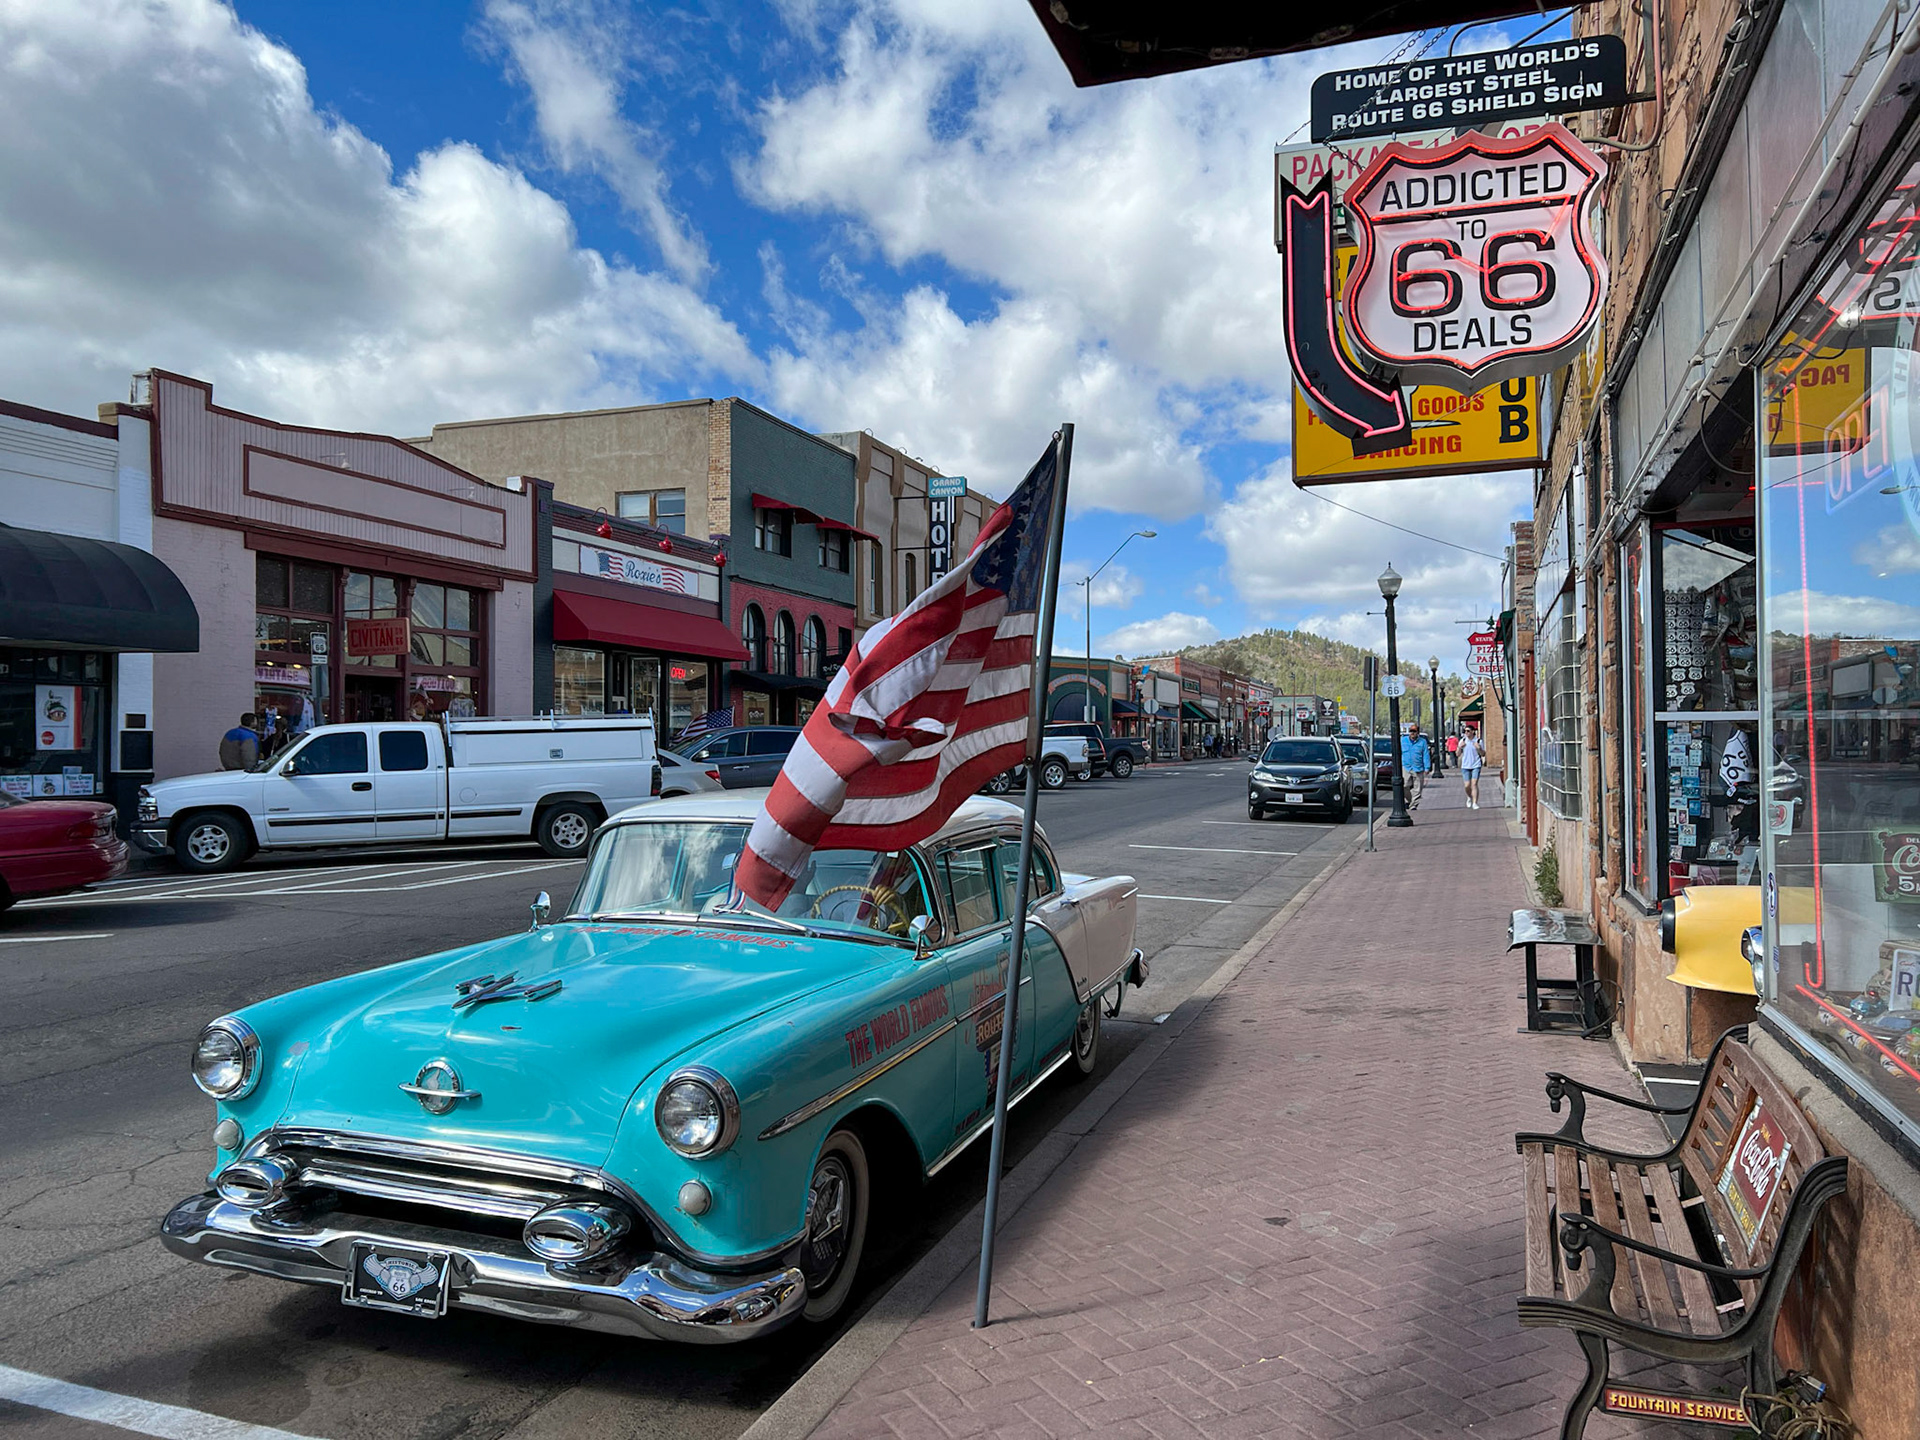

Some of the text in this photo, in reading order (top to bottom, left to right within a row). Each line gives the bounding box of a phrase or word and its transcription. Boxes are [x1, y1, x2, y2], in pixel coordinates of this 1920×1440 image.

[1335, 42, 1600, 92] HOME OF THE WORLD'S
[1375, 69, 1556, 106] LARGEST STEEL
[1332, 82, 1603, 131] ROUTE 66 SHIELD SIGN
[1379, 160, 1567, 212] ADDICTED
[1456, 219, 1486, 241] TO
[1389, 230, 1556, 318] 66
[1414, 314, 1532, 353] DEALS
[1418, 393, 1485, 416] GOODS
[1499, 377, 1530, 443] UB
[1353, 434, 1462, 461] CING
[930, 487, 963, 496] CANYON
[933, 478, 961, 487] GRAND
[625, 560, 661, 584] Roxie's
[350, 627, 394, 648] CIVITAN
[670, 666, 686, 680] OPEN
[1387, 686, 1400, 696] 66
[1721, 754, 1746, 780] 66
[695, 930, 795, 949] FAMOUS
[845, 984, 949, 1069] THE WORLD FAMOUS
[387, 1260, 416, 1270] HISTORIC
[393, 1282, 406, 1293] 66
[1610, 1392, 1745, 1422] FOUNTAIN SERVICE
